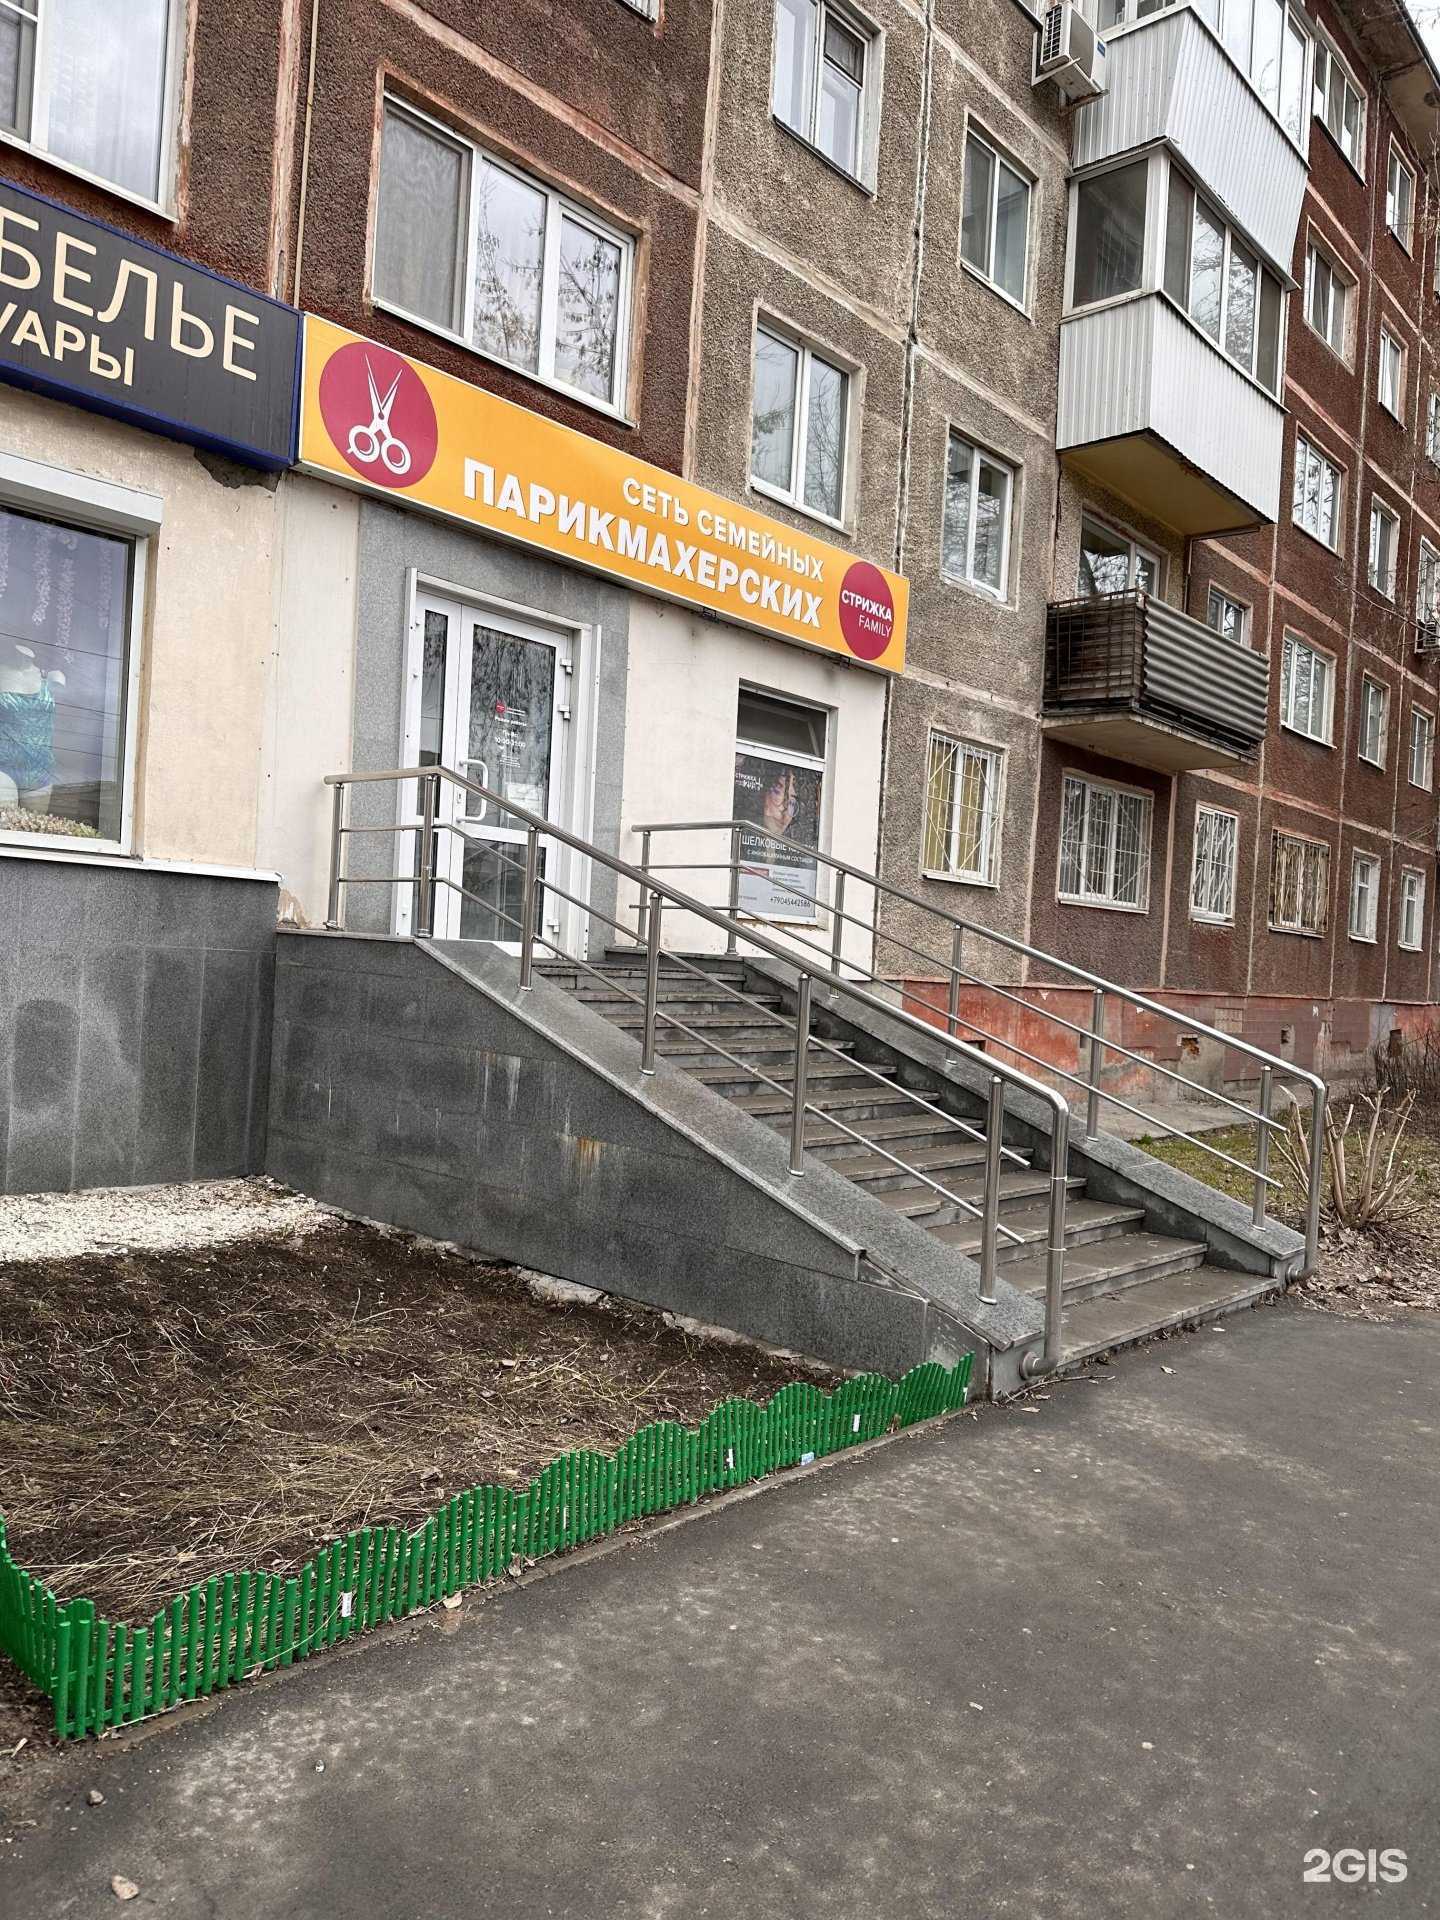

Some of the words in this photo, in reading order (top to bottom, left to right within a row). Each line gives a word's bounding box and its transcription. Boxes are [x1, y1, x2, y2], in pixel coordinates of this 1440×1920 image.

[0, 206, 260, 381] БЕЛЬЕ
[463, 457, 824, 630] ПАРИКМАХЕРСКИХ
[622, 477, 690, 526] СЕТЬ
[697, 510, 824, 583] СЕМЕЙНЫХ
[841, 589, 893, 622] СТРИЖКА
[858, 614, 893, 638] FAMILY
